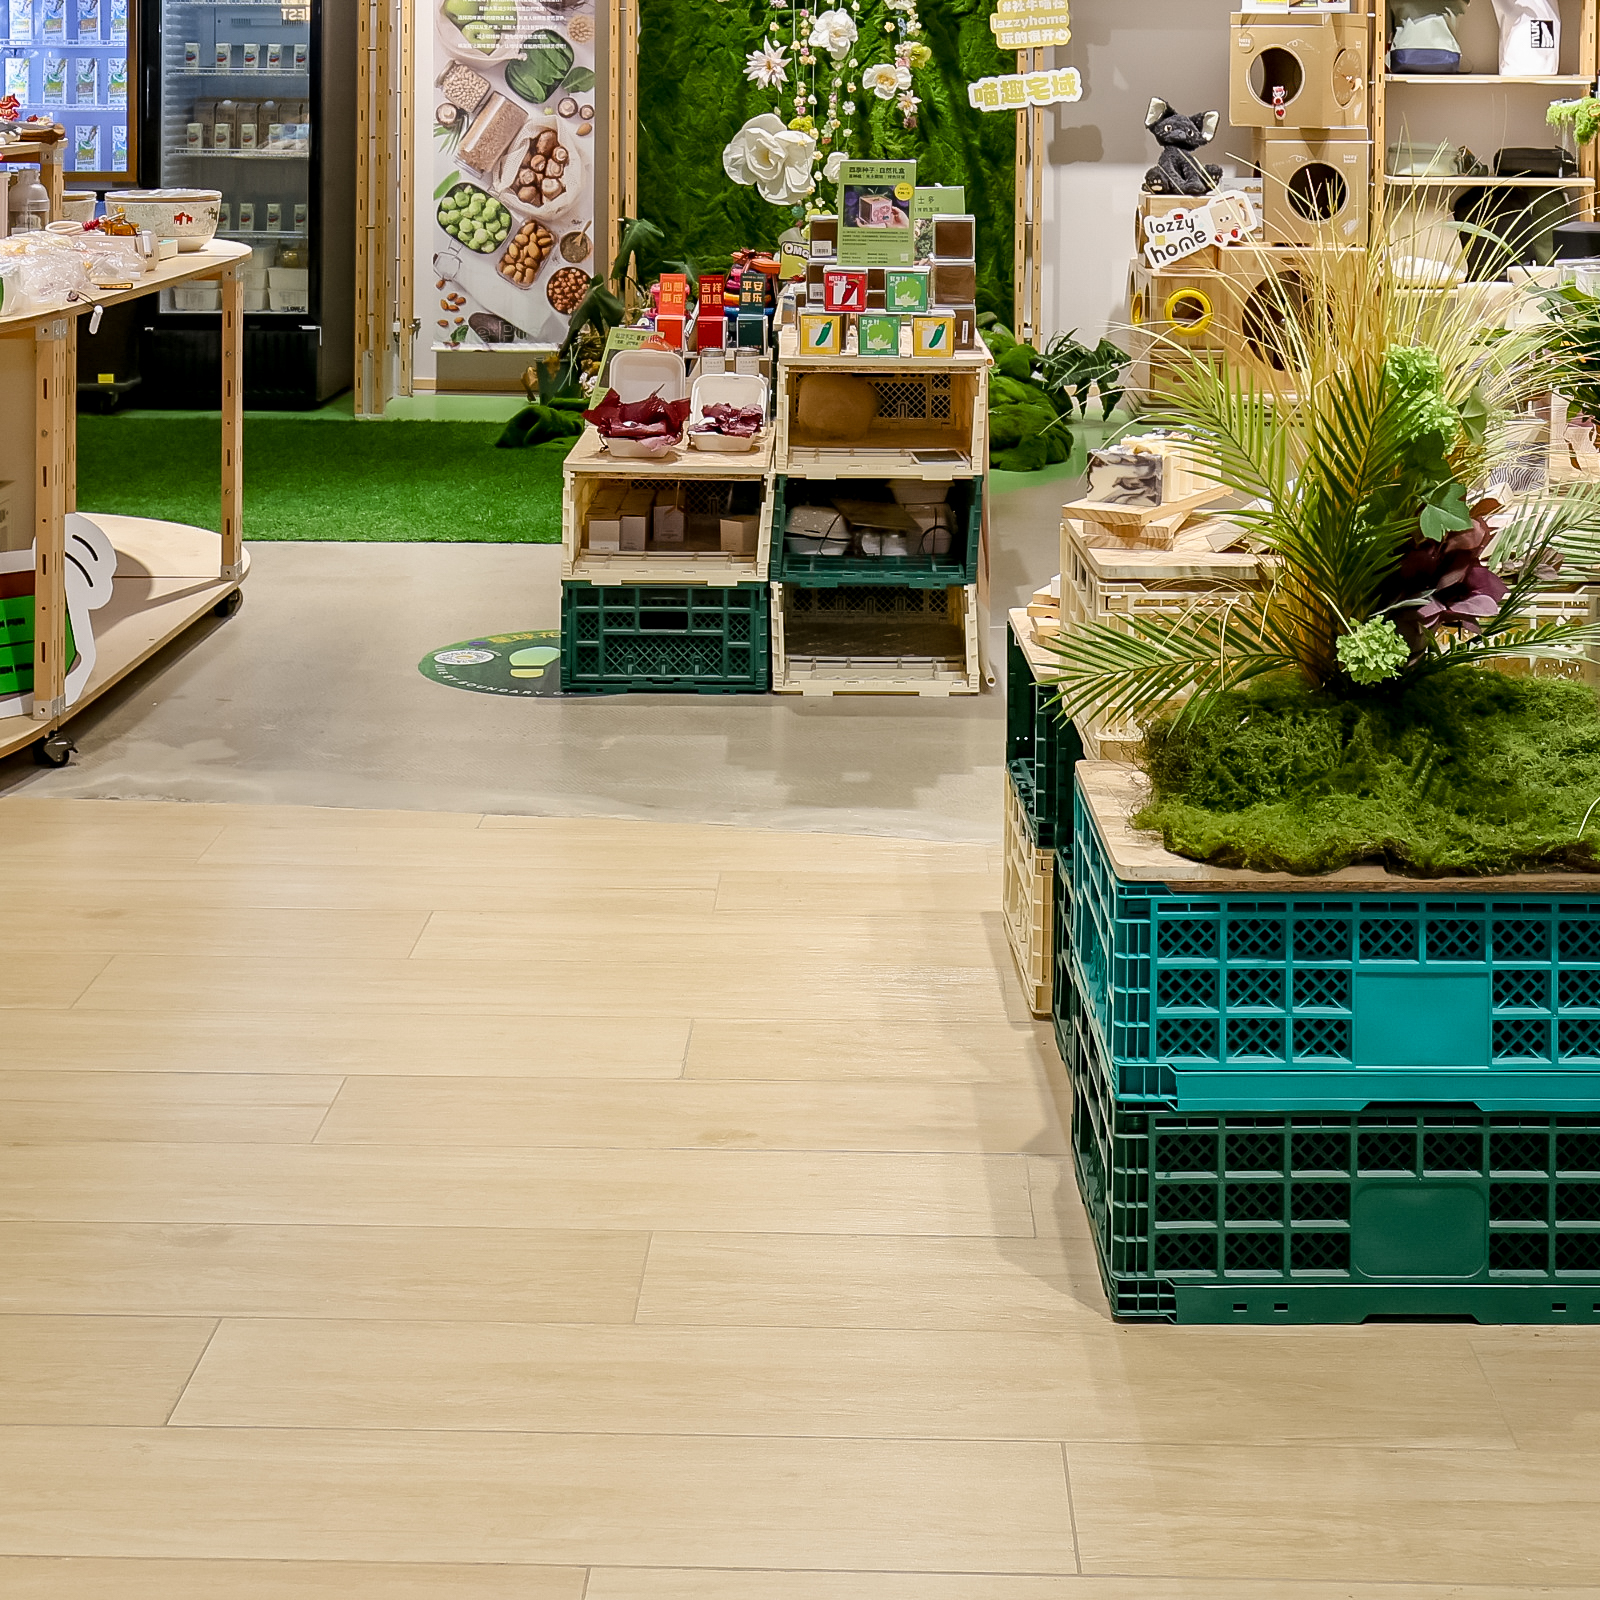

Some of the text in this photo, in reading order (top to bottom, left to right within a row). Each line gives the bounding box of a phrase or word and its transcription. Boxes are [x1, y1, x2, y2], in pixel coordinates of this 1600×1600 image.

[993, 15, 1067, 29] lazzyhome
[1001, 29, 1069, 44] 玩的很开心
[974, 73, 1078, 106] 喵趣宅域
[1149, 215, 1195, 234] lazzy
[1150, 229, 1208, 264] home
[662, 282, 683, 291] 心想
[701, 283, 722, 292] 吉祥
[742, 281, 764, 291] 平安
[701, 294, 722, 304] 如意
[741, 292, 762, 302] 喜乐
[6, 617, 25, 628] FUN
